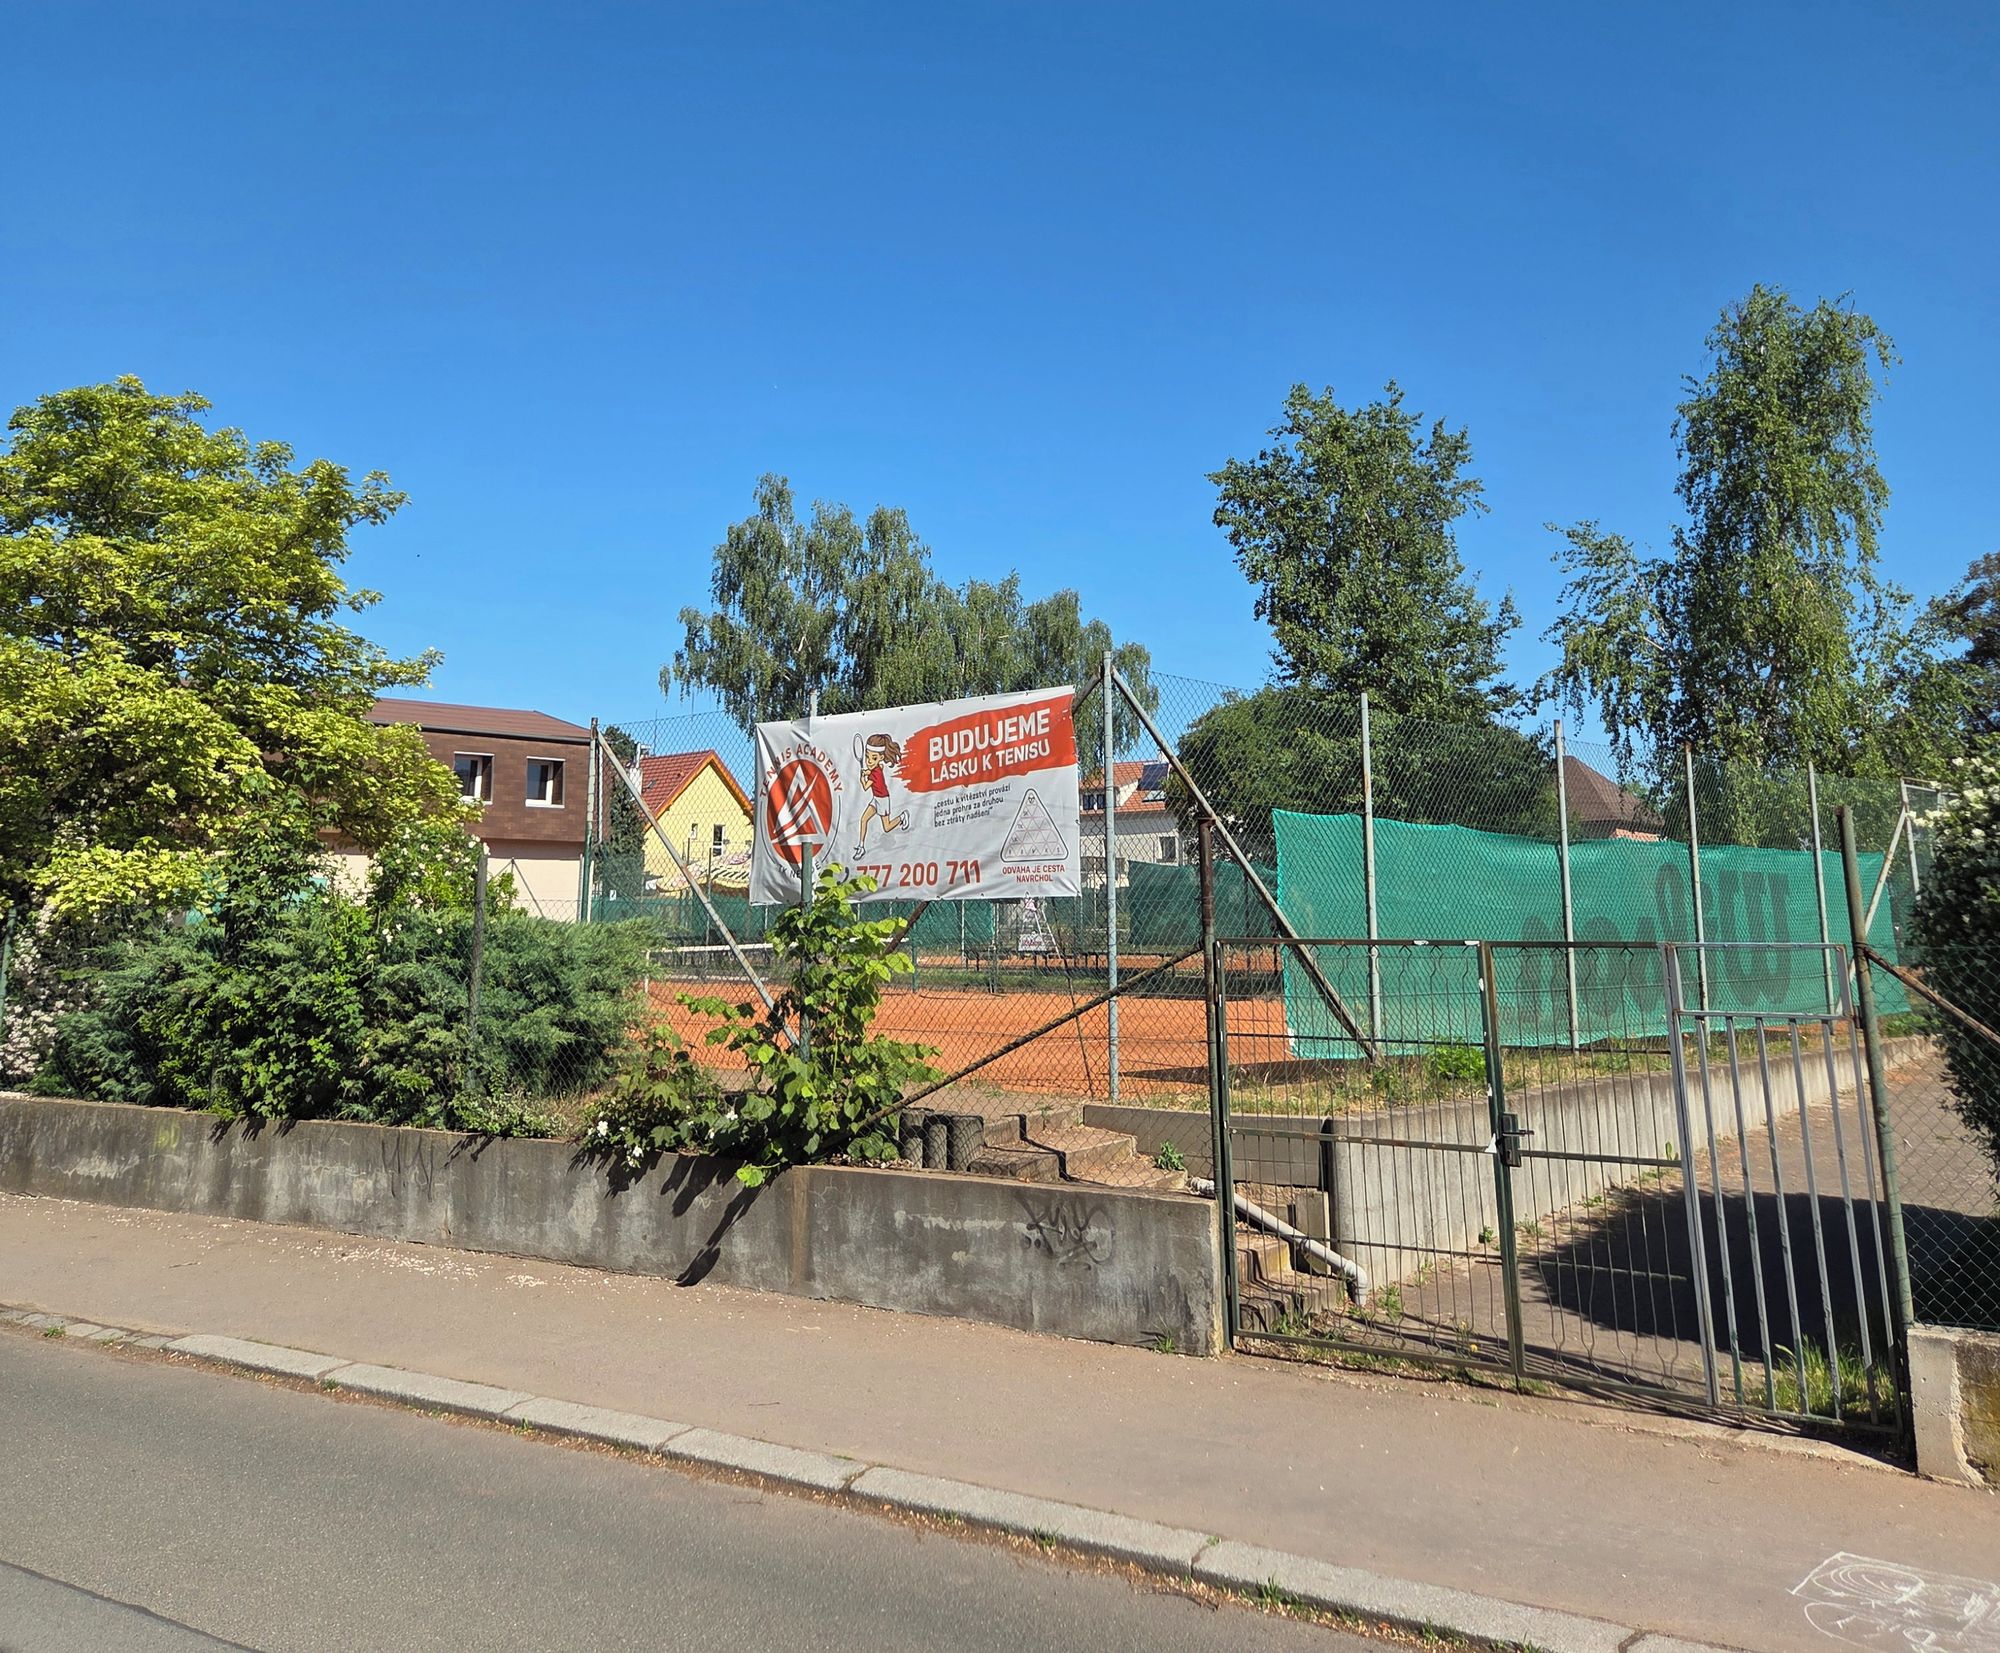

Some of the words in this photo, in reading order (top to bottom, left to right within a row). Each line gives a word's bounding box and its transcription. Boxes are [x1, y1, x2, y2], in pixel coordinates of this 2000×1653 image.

[929, 707, 1051, 762] BUDUJEME
[760, 747, 792, 798] TENNIS
[796, 743, 843, 793] ACADEMY
[930, 757, 978, 784] LÁSKU
[982, 753, 993, 771] K
[995, 739, 1051, 767] TENISU
[952, 803, 972, 816] prohra
[981, 796, 1004, 807] druhou
[934, 819, 945, 828] bez
[946, 814, 966, 824] ztráty
[899, 862, 939, 887] 200
[946, 859, 981, 885] 711
[1002, 865, 1031, 875] ODVAHA
[1032, 865, 1041, 873] JE
[1042, 864, 1065, 873] CESTA
[1016, 874, 1054, 883] NAVRCHOL
